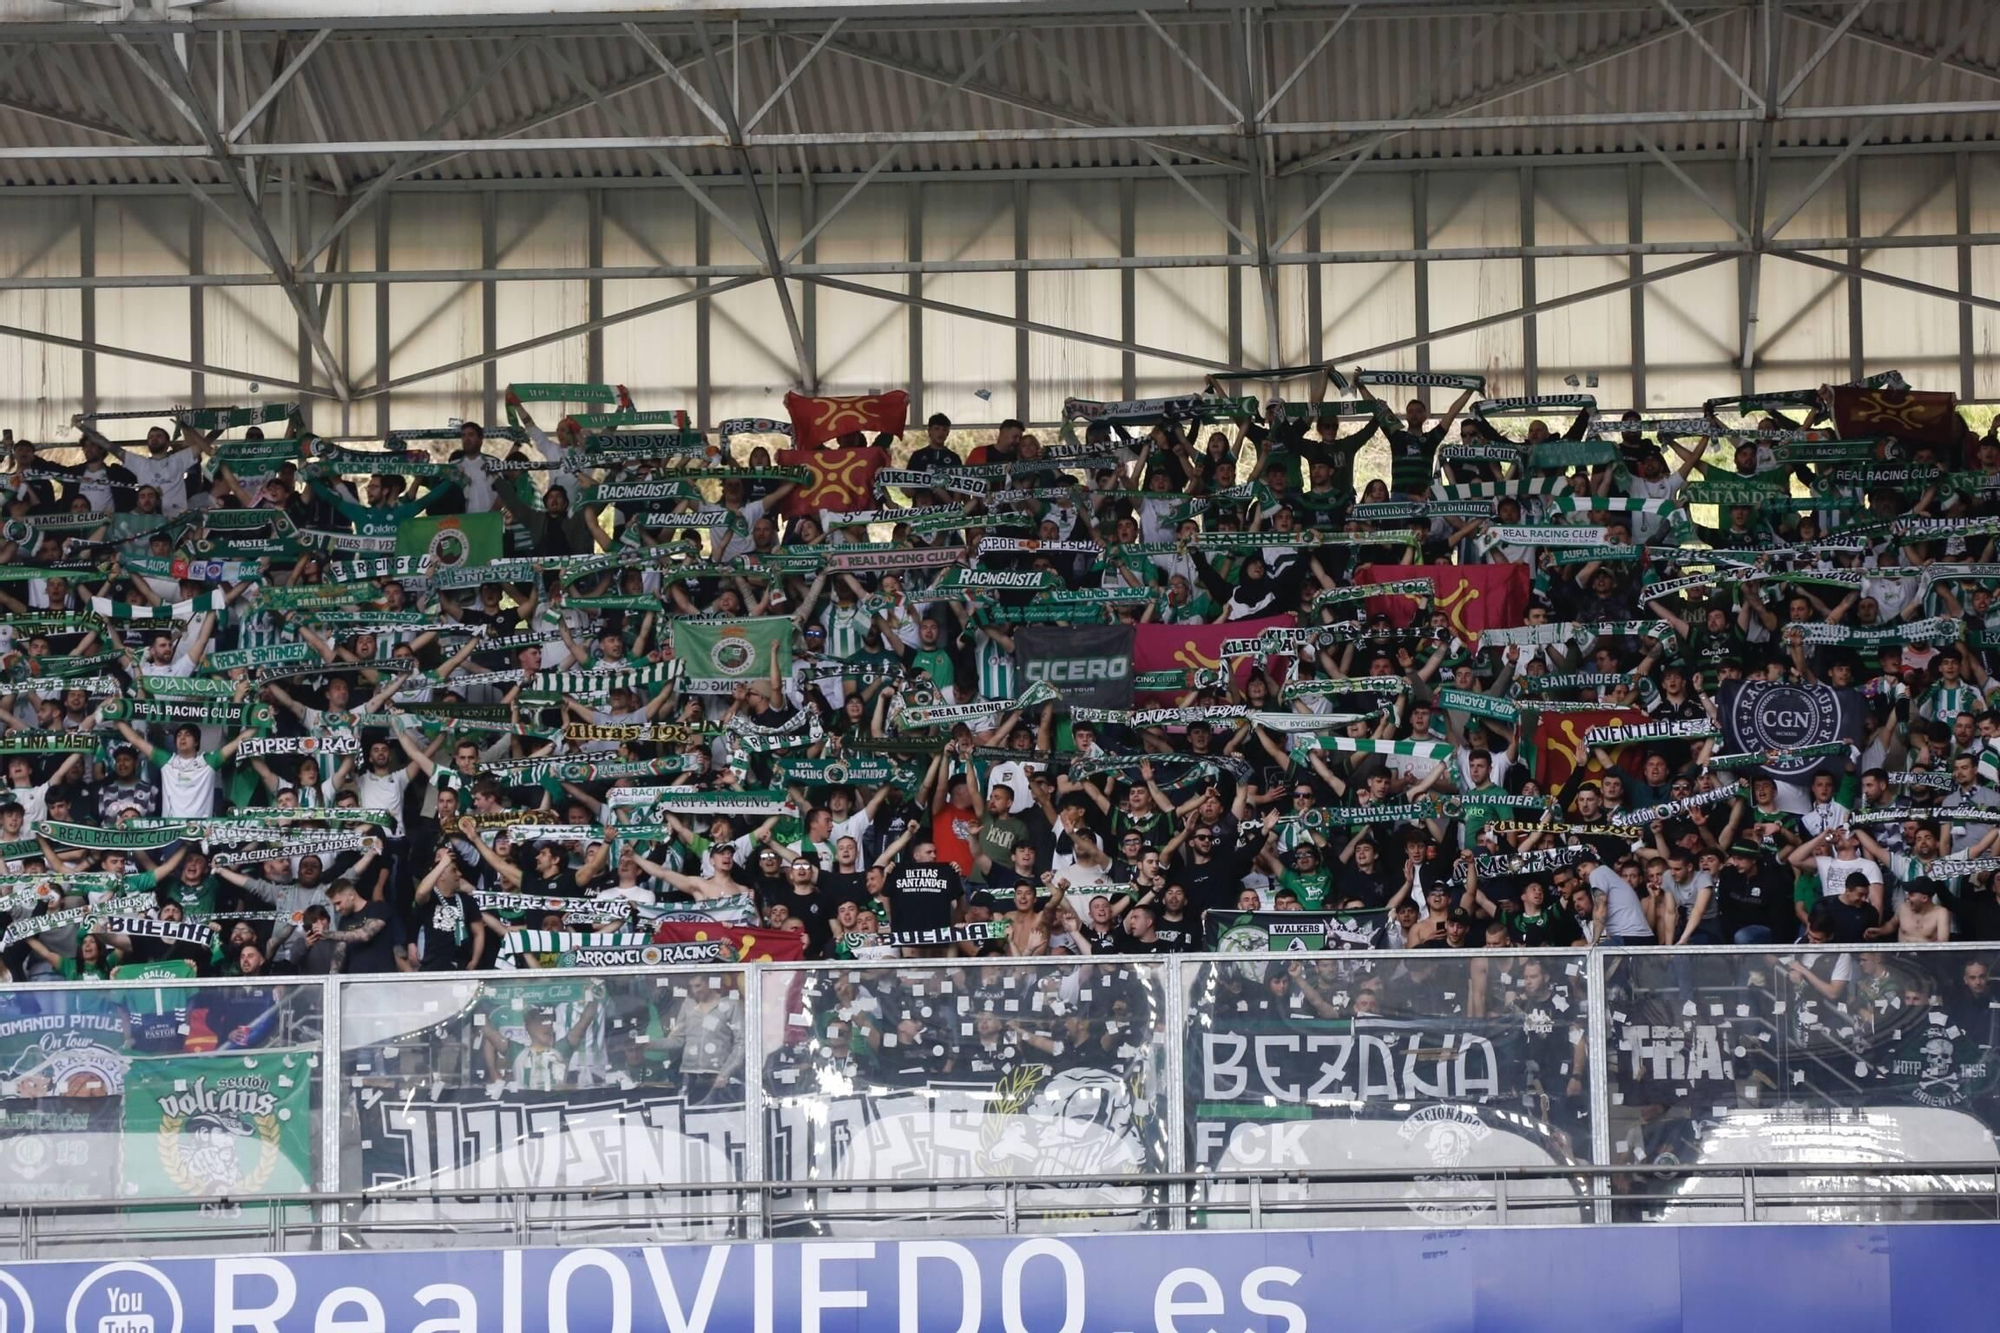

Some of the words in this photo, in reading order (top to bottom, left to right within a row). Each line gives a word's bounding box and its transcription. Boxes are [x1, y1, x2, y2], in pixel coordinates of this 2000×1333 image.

[241, 446, 272, 455] RACING
[1836, 470, 1865, 481] REAL
[1866, 470, 1909, 481] RACING
[1911, 468, 1940, 479] CLUB
[34, 514, 74, 526] RACING
[77, 512, 104, 523] CLUB
[1502, 529, 1528, 538] REAL
[1530, 529, 1569, 538] RACING
[1571, 529, 1598, 538] CLUB
[228, 539, 270, 548] AMSTEL
[848, 555, 878, 567] REAL
[879, 553, 924, 565] RACING
[926, 550, 957, 562] CLUB
[1562, 548, 1591, 560] AUPA
[1592, 545, 1636, 557] RACING!
[356, 561, 405, 572] RACING
[215, 650, 249, 668] RACING
[252, 643, 304, 664] SANTANDER
[1026, 657, 1128, 682] CICERO
[1540, 672, 1621, 688] SANTANDER
[134, 704, 163, 716] REAL
[165, 705, 208, 718] RACING
[211, 706, 241, 719] CLUB
[932, 708, 959, 719] REAL
[962, 702, 1002, 716] RACING
[1489, 700, 1517, 715] AUPA
[1762, 710, 1810, 729] CGN
[597, 763, 626, 774] RACING
[788, 769, 823, 780] RACING
[671, 796, 708, 808] AUPA
[716, 796, 771, 808] RACING
[59, 827, 91, 843] REAL
[94, 830, 145, 845] RACING
[230, 845, 278, 862] RACING
[282, 839, 359, 857] SANTANDER
[568, 898, 631, 918] RACING
[109, 916, 213, 946] BUELNA
[1274, 924, 1320, 933] WALKERS
[663, 946, 720, 963] RACING
[41, 1031, 66, 1053] On
[66, 1028, 93, 1049] tour
[1202, 1031, 1499, 1101] BEZANA
[217, 1074, 270, 1092] sección
[158, 1075, 279, 1119] volcans
[1196, 1121, 1312, 1166] FCK
[214, 1237, 1307, 1333] RealOVIEDOes
[106, 1286, 143, 1313] You
